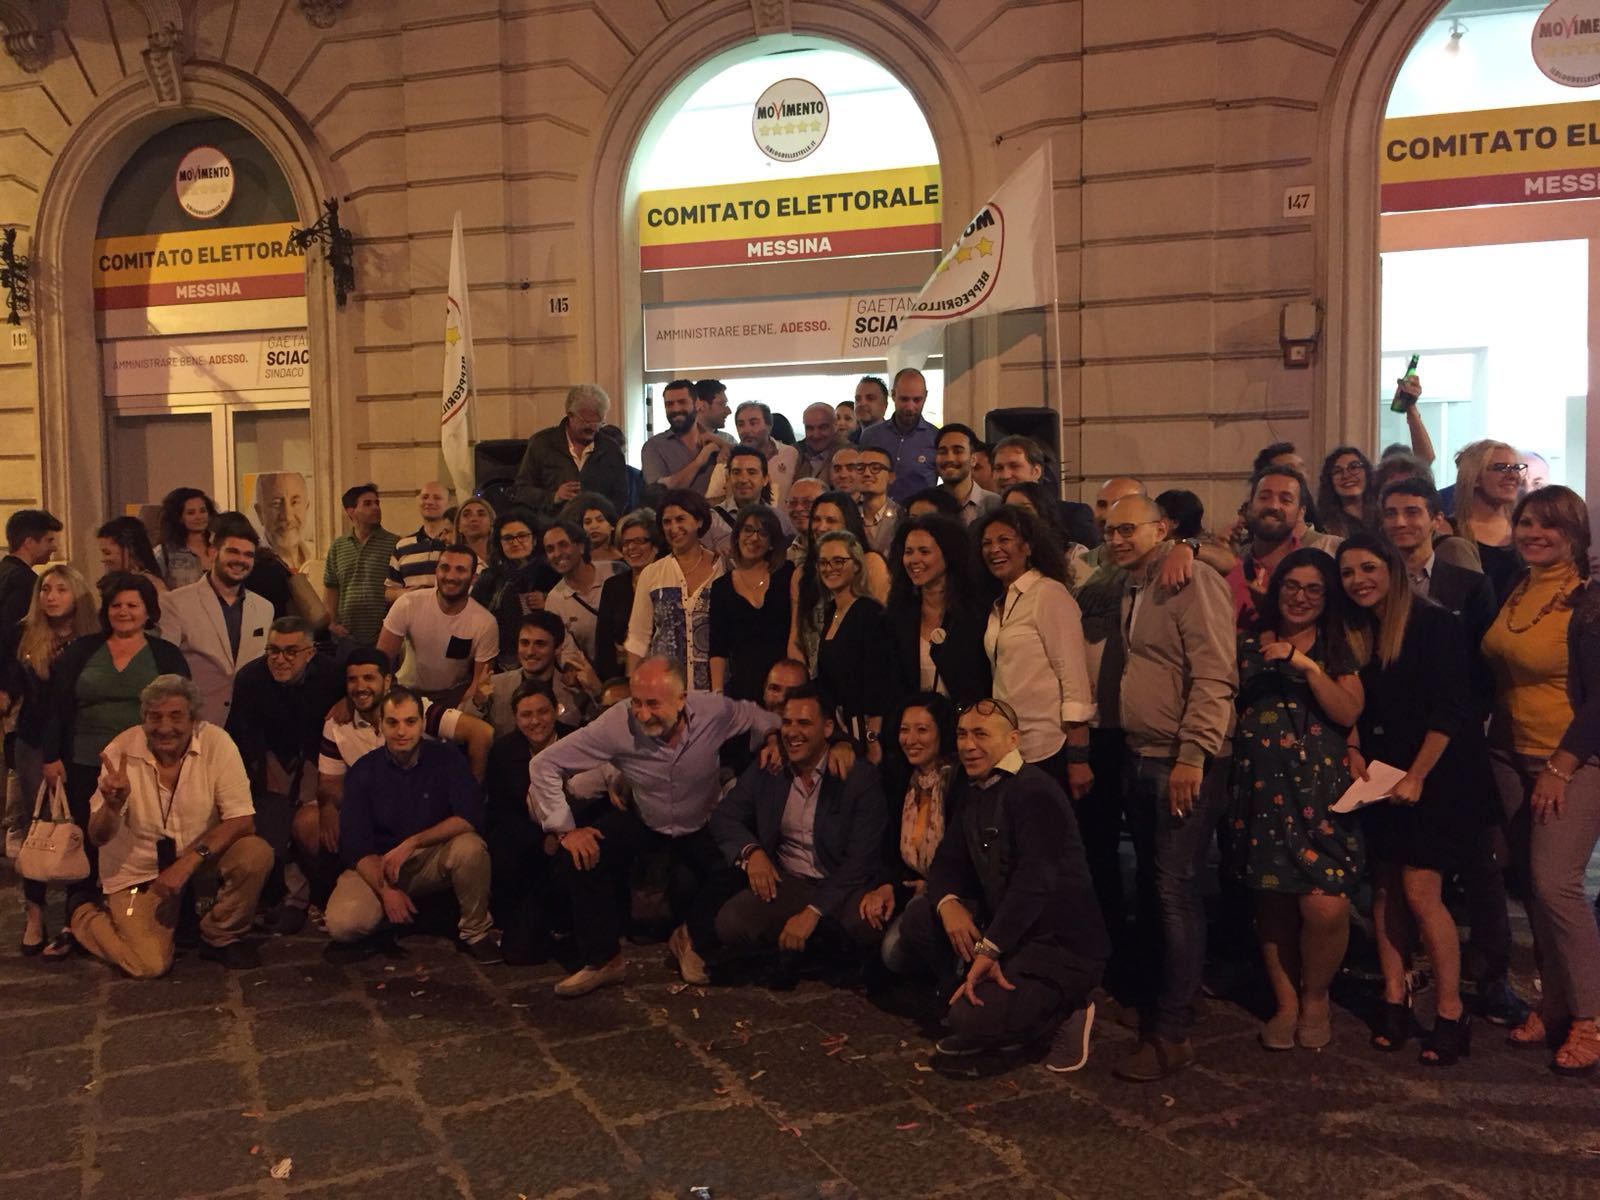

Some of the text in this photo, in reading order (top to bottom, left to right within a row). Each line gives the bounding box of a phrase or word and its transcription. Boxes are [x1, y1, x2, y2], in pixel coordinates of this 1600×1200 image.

[757, 99, 824, 120] MOVIMENTO
[1387, 126, 1557, 162] COMITATO
[179, 165, 230, 182] MOVIMENTO
[647, 184, 939, 227] COMITATO ELETTORALE
[1288, 194, 1310, 210] 147
[748, 237, 832, 257] MESSINA
[99, 248, 193, 272] COMITATO
[176, 281, 241, 299] MESSINA
[550, 297, 569, 313] 145
[656, 325, 739, 341] AMMINISTRARE
[780, 320, 831, 334] ADESSO.
[855, 315, 899, 334] SCIA
[267, 334, 305, 348] GAETA
[113, 357, 178, 370] AMMINISTRARE
[209, 353, 248, 365] ADESSO.
[265, 367, 304, 379] SINDACO
